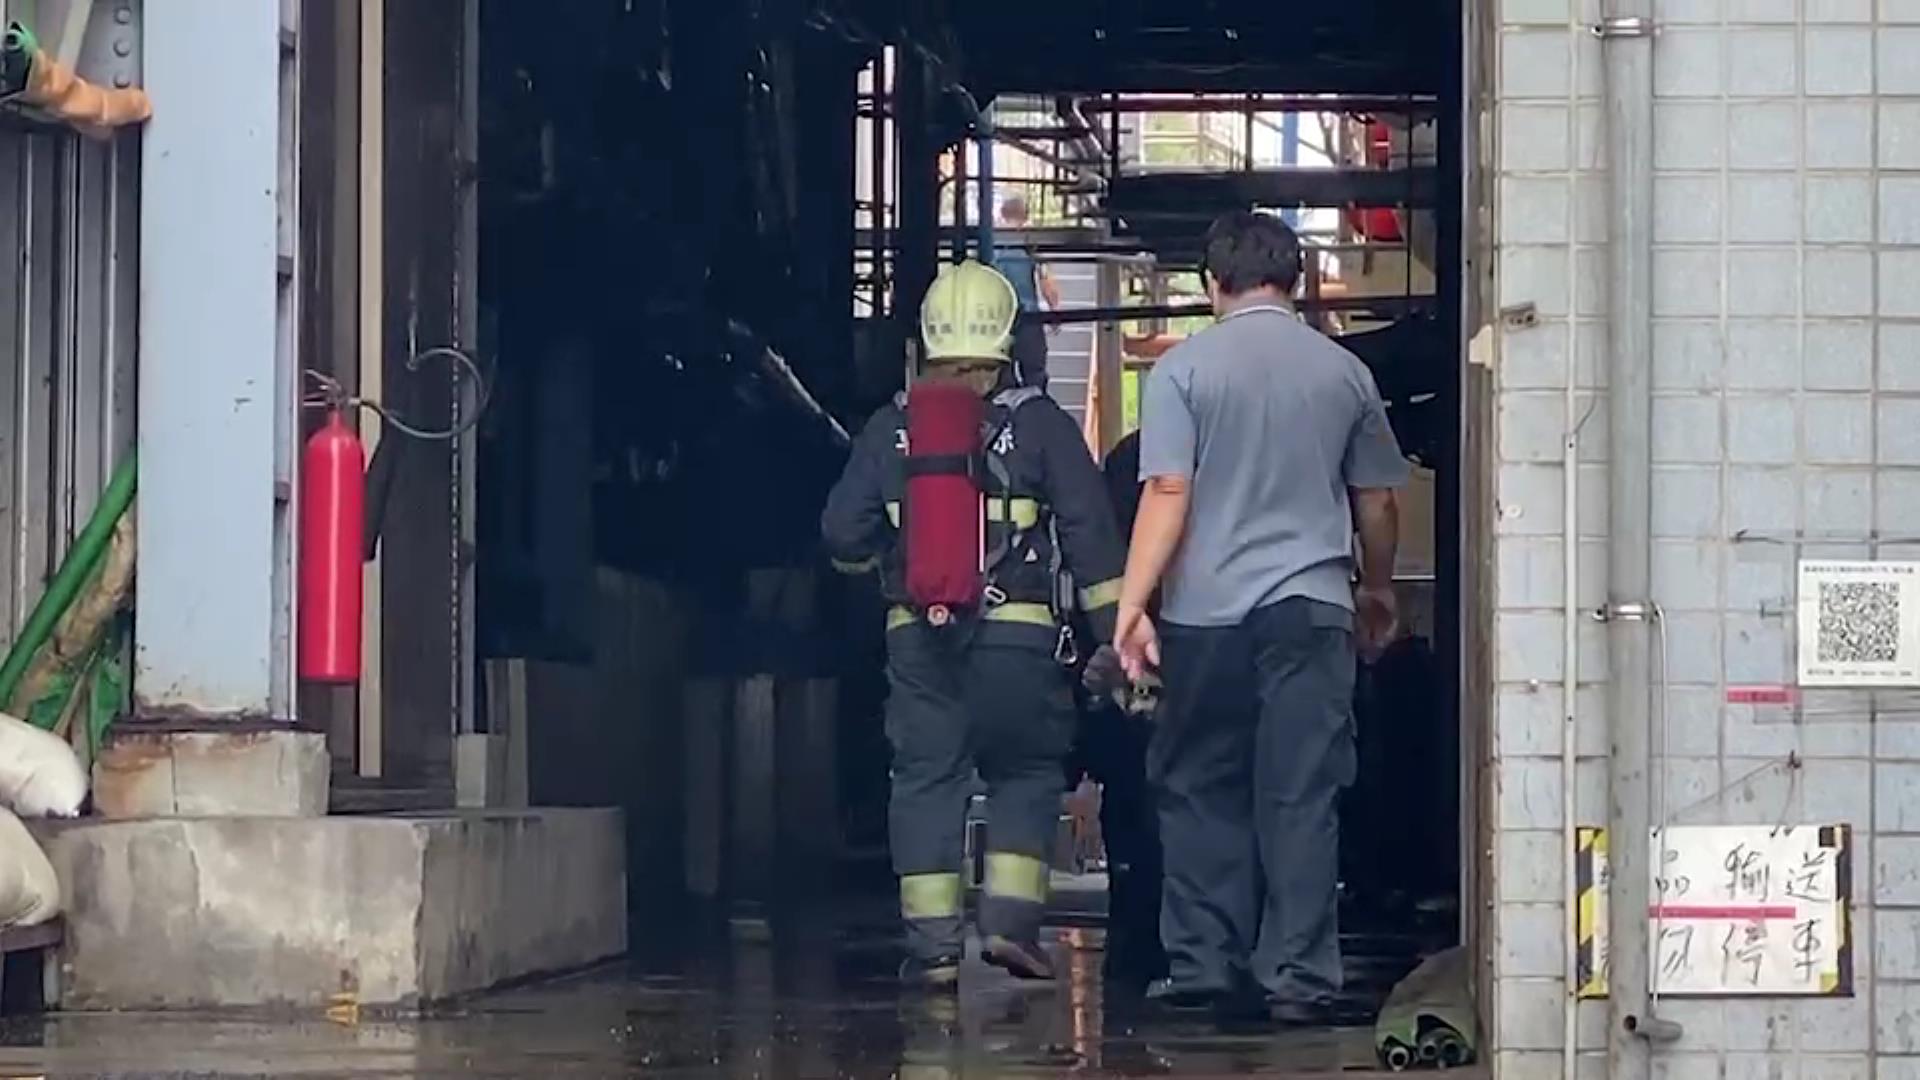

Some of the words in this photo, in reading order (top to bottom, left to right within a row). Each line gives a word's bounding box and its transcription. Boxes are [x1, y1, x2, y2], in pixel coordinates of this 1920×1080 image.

[1600, 843, 1832, 903] 品輸送
[1600, 919, 1823, 987] 勿停車
